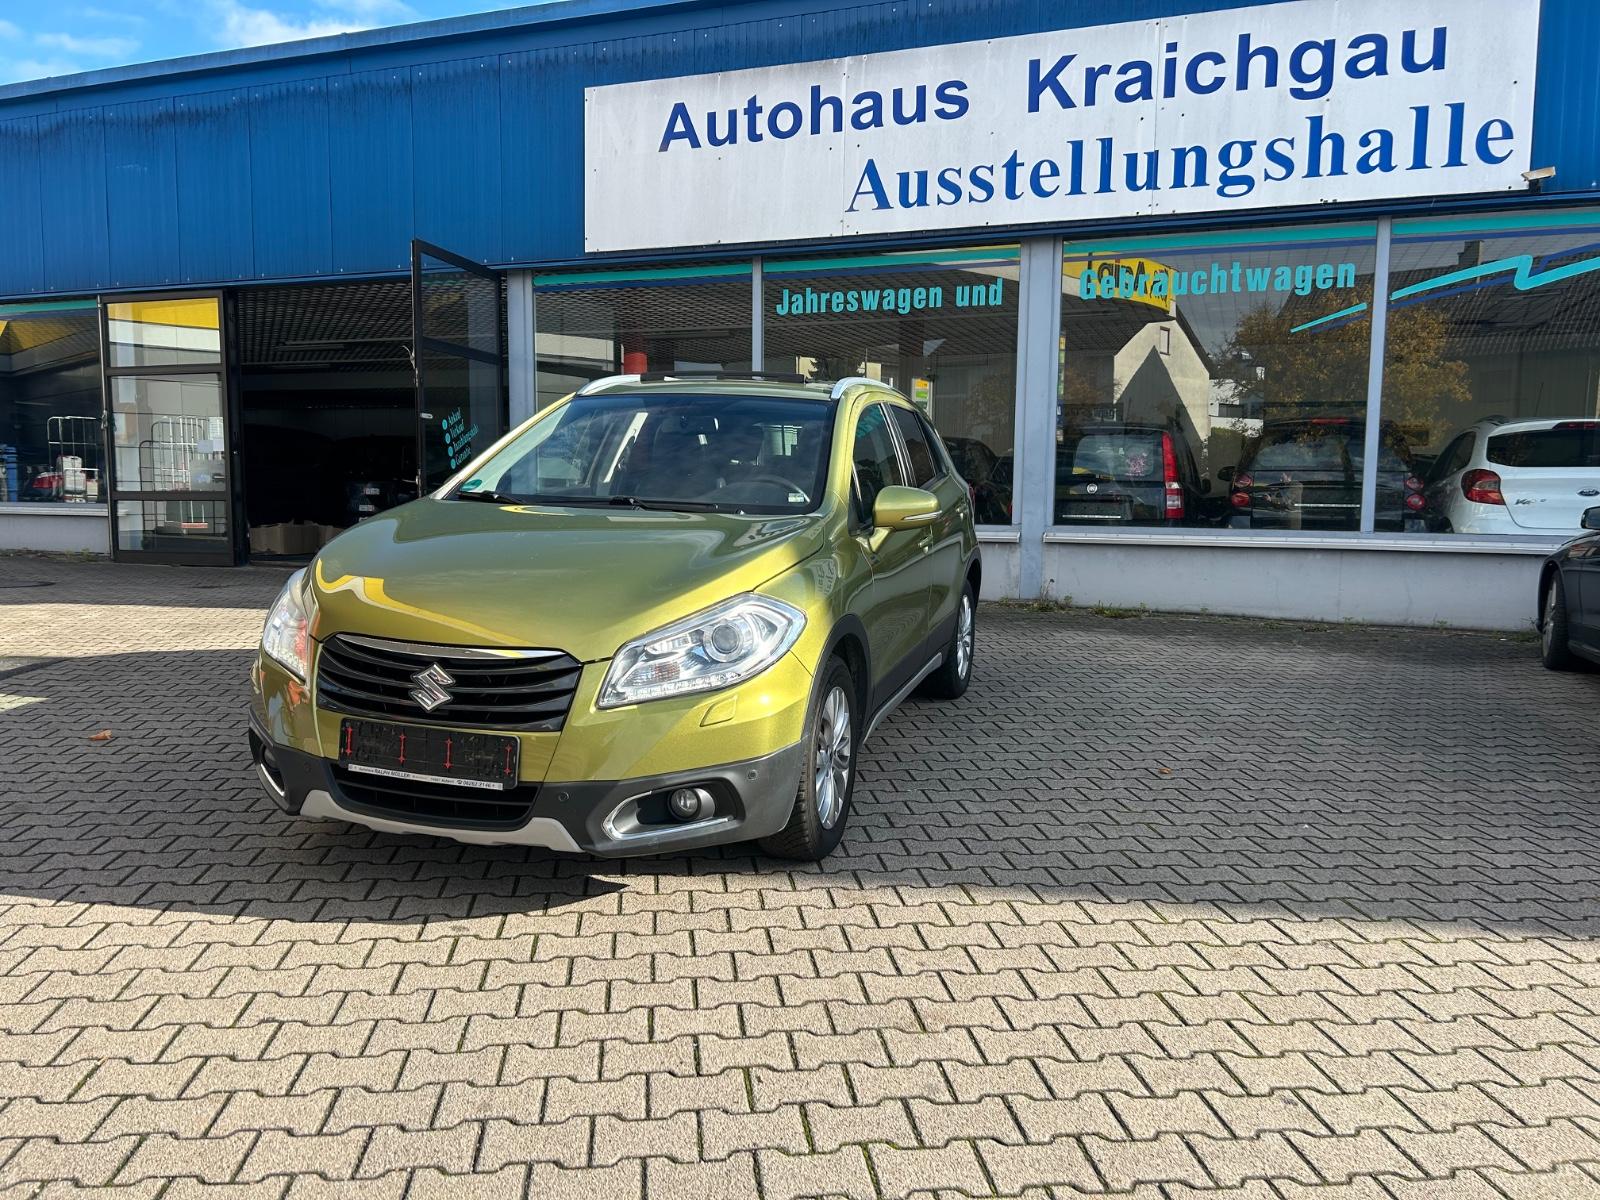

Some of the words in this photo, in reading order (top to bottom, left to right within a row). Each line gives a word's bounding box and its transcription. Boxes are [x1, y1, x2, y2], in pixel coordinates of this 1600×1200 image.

[658, 80, 970, 153] Autohaus
[1027, 26, 1448, 113] Kraichgau
[844, 102, 1515, 213] Ausstellungshalle
[775, 285, 943, 316] Jahreswagen
[956, 277, 1004, 307] und
[1079, 261, 1357, 301] Gebrauchtwagen
